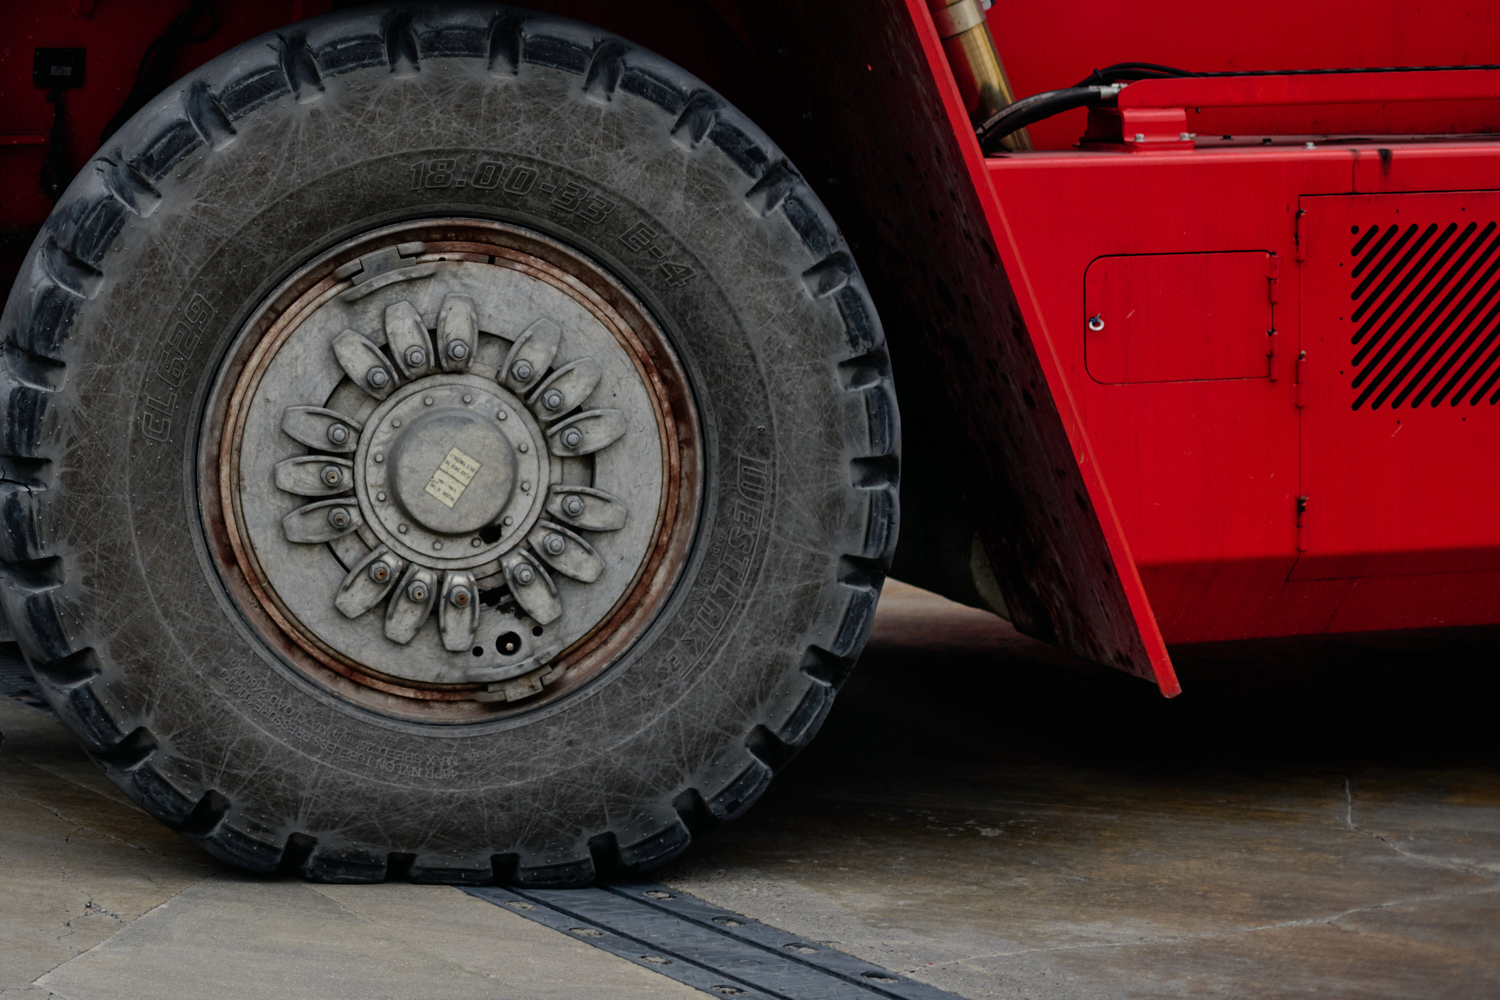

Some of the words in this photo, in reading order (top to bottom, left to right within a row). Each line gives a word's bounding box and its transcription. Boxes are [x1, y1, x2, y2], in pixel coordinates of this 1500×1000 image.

[410, 158, 616, 224] 18.00-33
[619, 220, 698, 288] E-4
[142, 292, 216, 443] CL629
[666, 454, 768, 680] WESTLAKE
[253, 697, 314, 744] PRESSURE
[267, 693, 303, 721] LOAD
[310, 733, 374, 767] TUBELESS
[376, 745, 423, 764] SPEED
[424, 753, 458, 766] MAX
[374, 757, 422, 777] NYLON
[423, 765, 459, 779] 40PR
